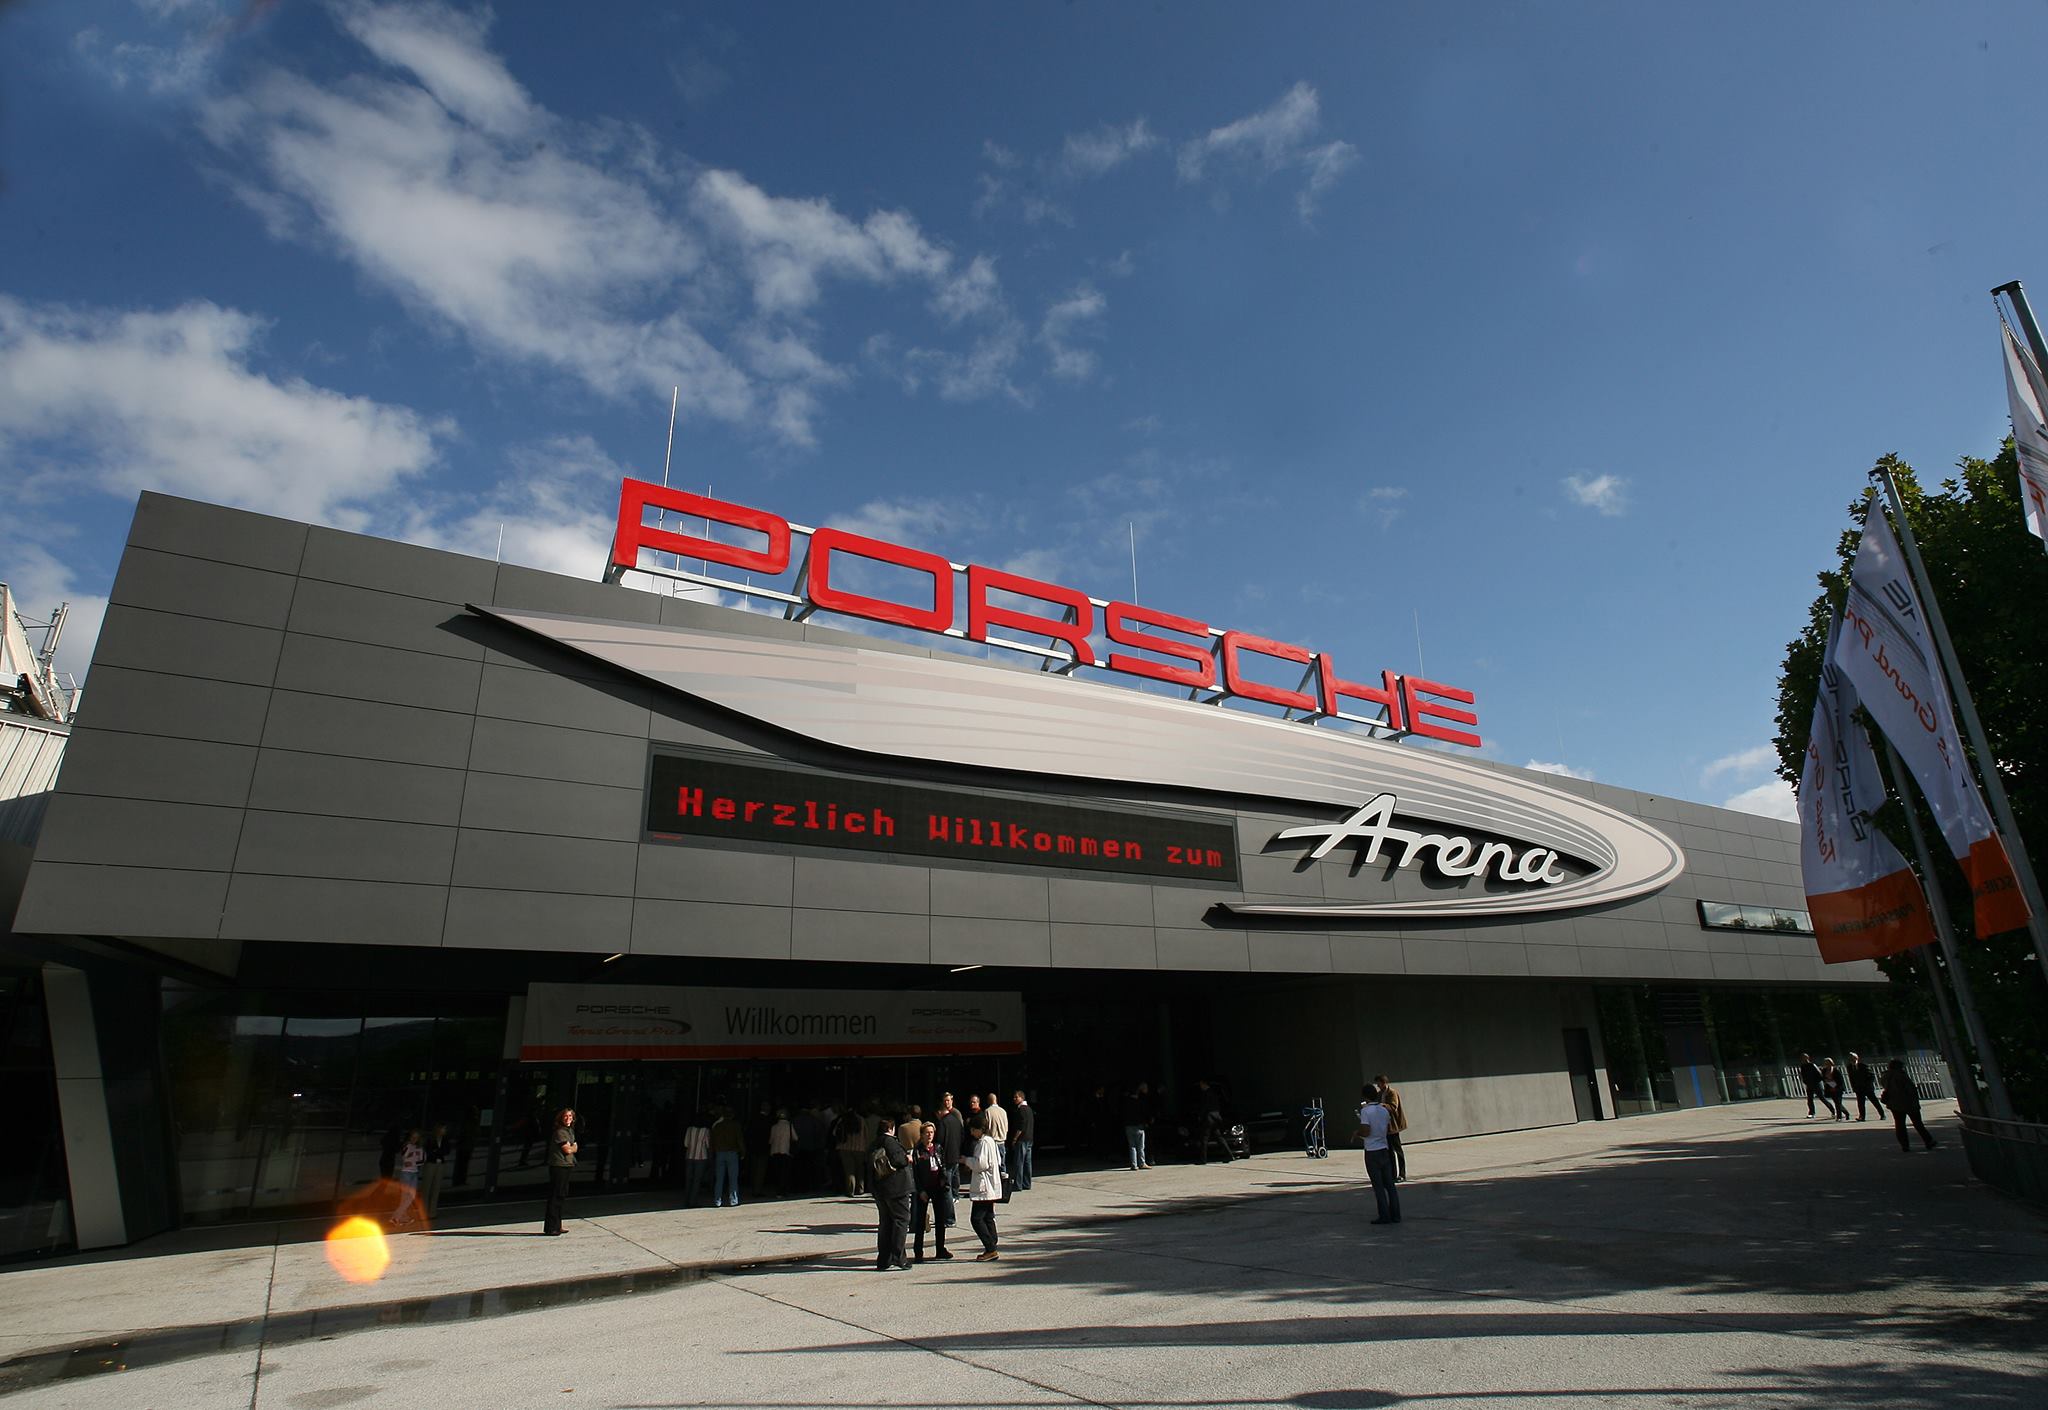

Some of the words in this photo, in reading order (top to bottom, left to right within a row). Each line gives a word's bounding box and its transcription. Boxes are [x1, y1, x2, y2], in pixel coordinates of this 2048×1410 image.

[614, 477, 1482, 748] PORSCHE
[677, 786, 895, 838] Herzlich
[928, 814, 1143, 861] Willkommen
[1166, 844, 1223, 868] zum
[1278, 792, 1565, 885] Arena
[576, 1004, 673, 1015] PORSCHE
[725, 1006, 877, 1035] Willkommen
